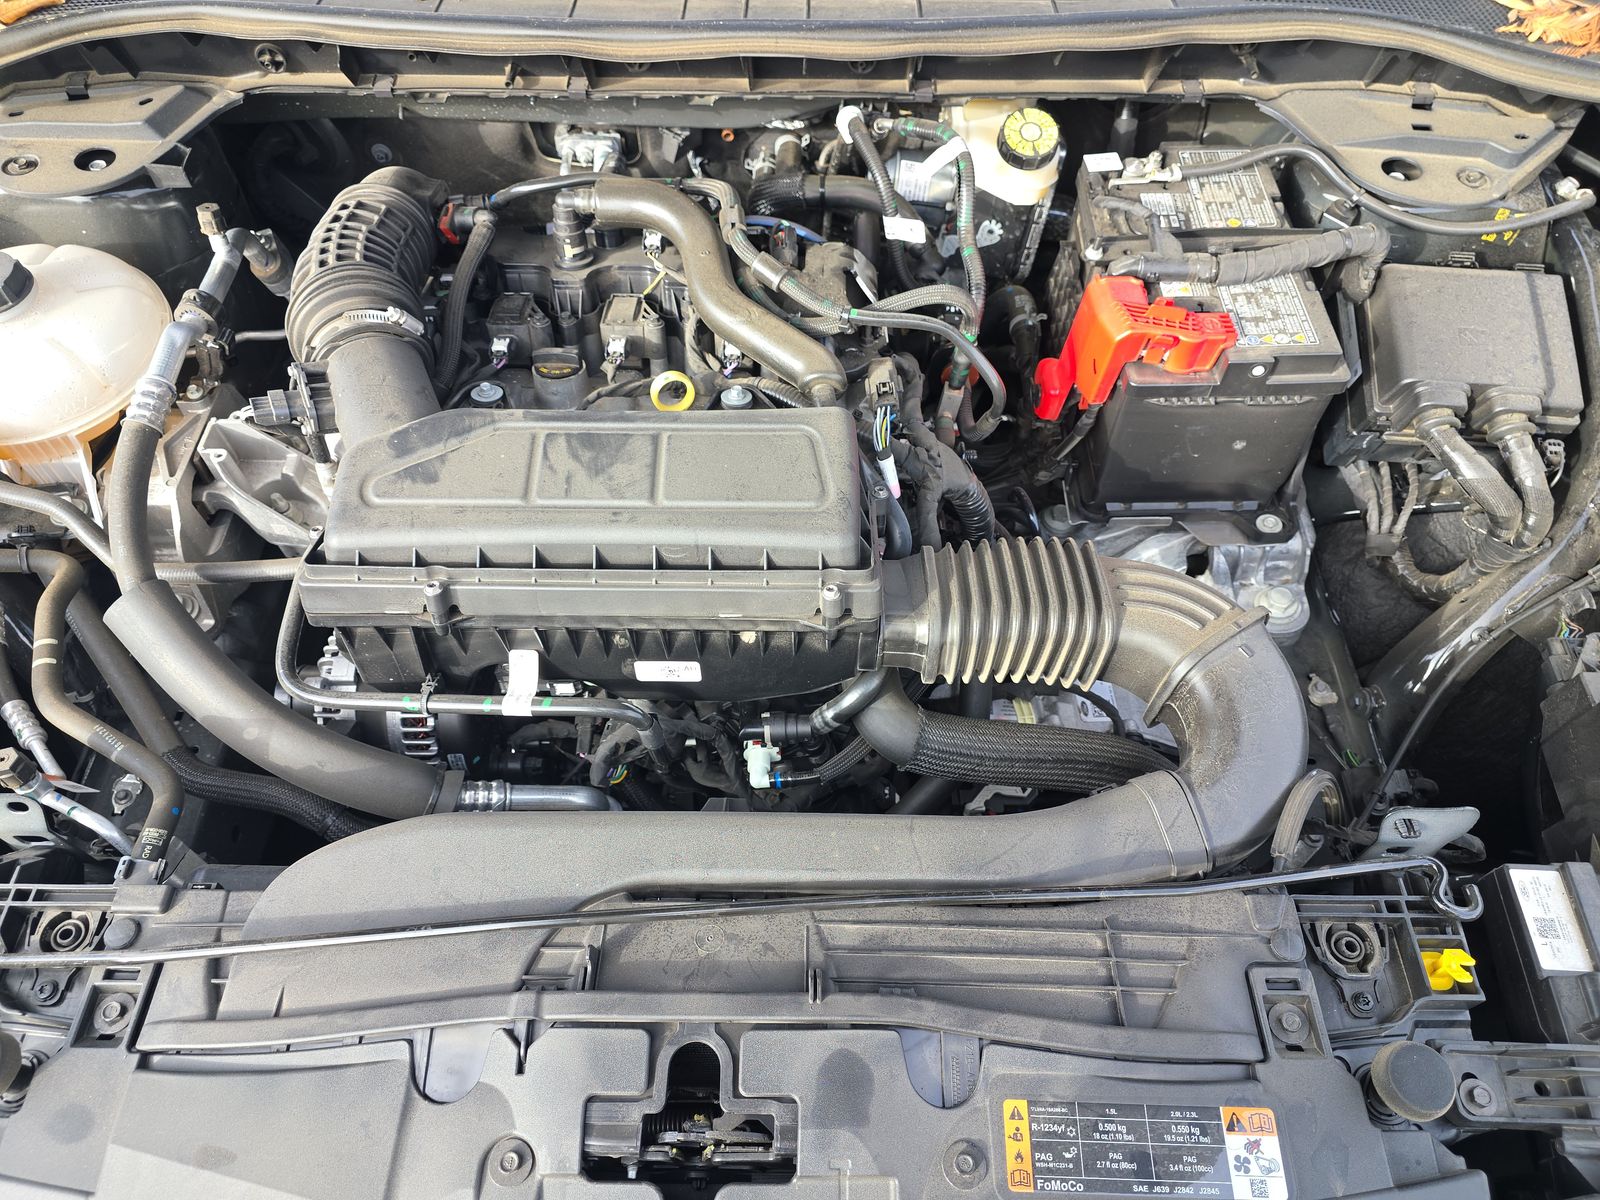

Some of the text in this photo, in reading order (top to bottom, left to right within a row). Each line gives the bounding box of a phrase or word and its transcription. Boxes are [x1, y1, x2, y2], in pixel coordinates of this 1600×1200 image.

[1031, 1123, 1066, 1134] R-1234yf
[1098, 1122, 1127, 1133] 0.500 kg
[1171, 1125, 1200, 1136] 0.550 kg
[1093, 1132, 1100, 1140] 18
[1109, 1133, 1123, 1141] (1.10
[1123, 1133, 1135, 1142] lbs)
[1163, 1134, 1176, 1142] 19.5
[1184, 1135, 1199, 1143] (1.21
[1199, 1135, 1211, 1144] lbs)
[1034, 1152, 1053, 1161] PAG
[1108, 1152, 1123, 1160] PAG
[1182, 1155, 1197, 1163] PAG
[1119, 1161, 1137, 1171] (80cc)
[1192, 1165, 1214, 1174] (100cc)
[1037, 1180, 1084, 1192] FoMoCo
[1132, 1184, 1220, 1195] SAE J639 J2842 J2845
